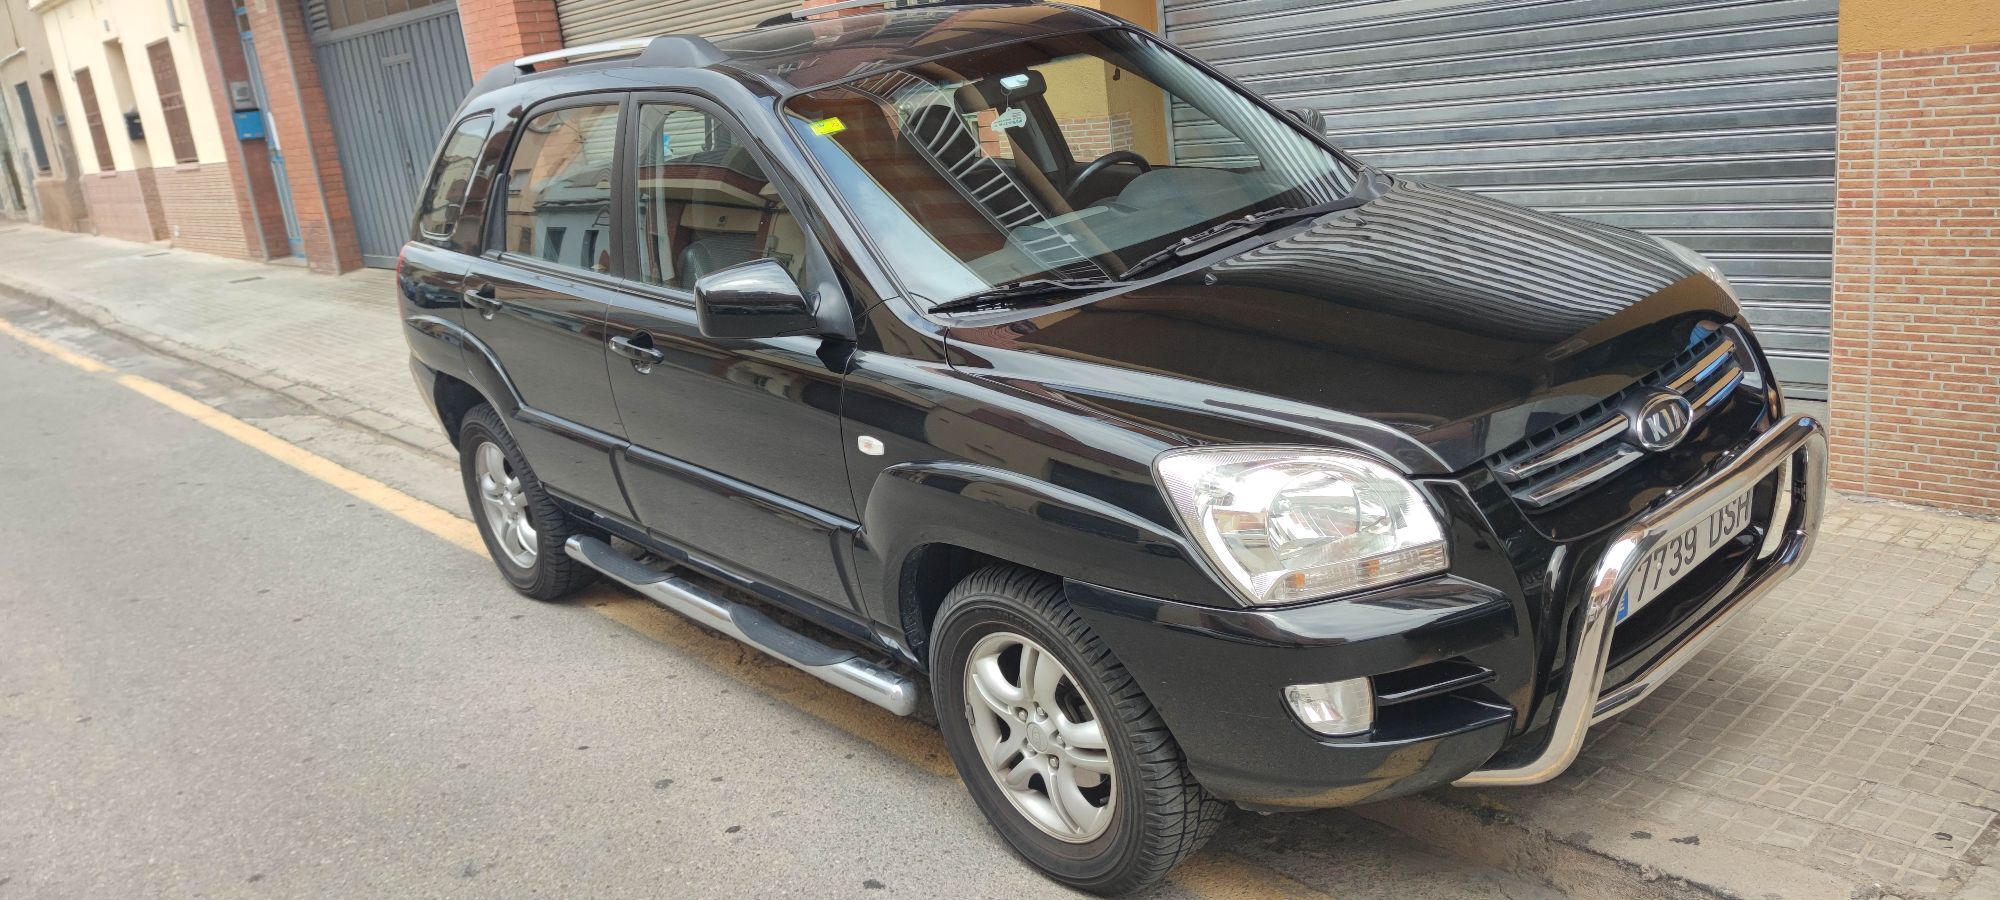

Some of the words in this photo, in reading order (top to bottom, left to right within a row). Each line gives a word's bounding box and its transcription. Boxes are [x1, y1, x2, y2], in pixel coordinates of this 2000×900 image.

[1645, 403, 1687, 442] KIA
[1638, 527, 1698, 602] 7739
[1709, 488, 1752, 548] DSH
